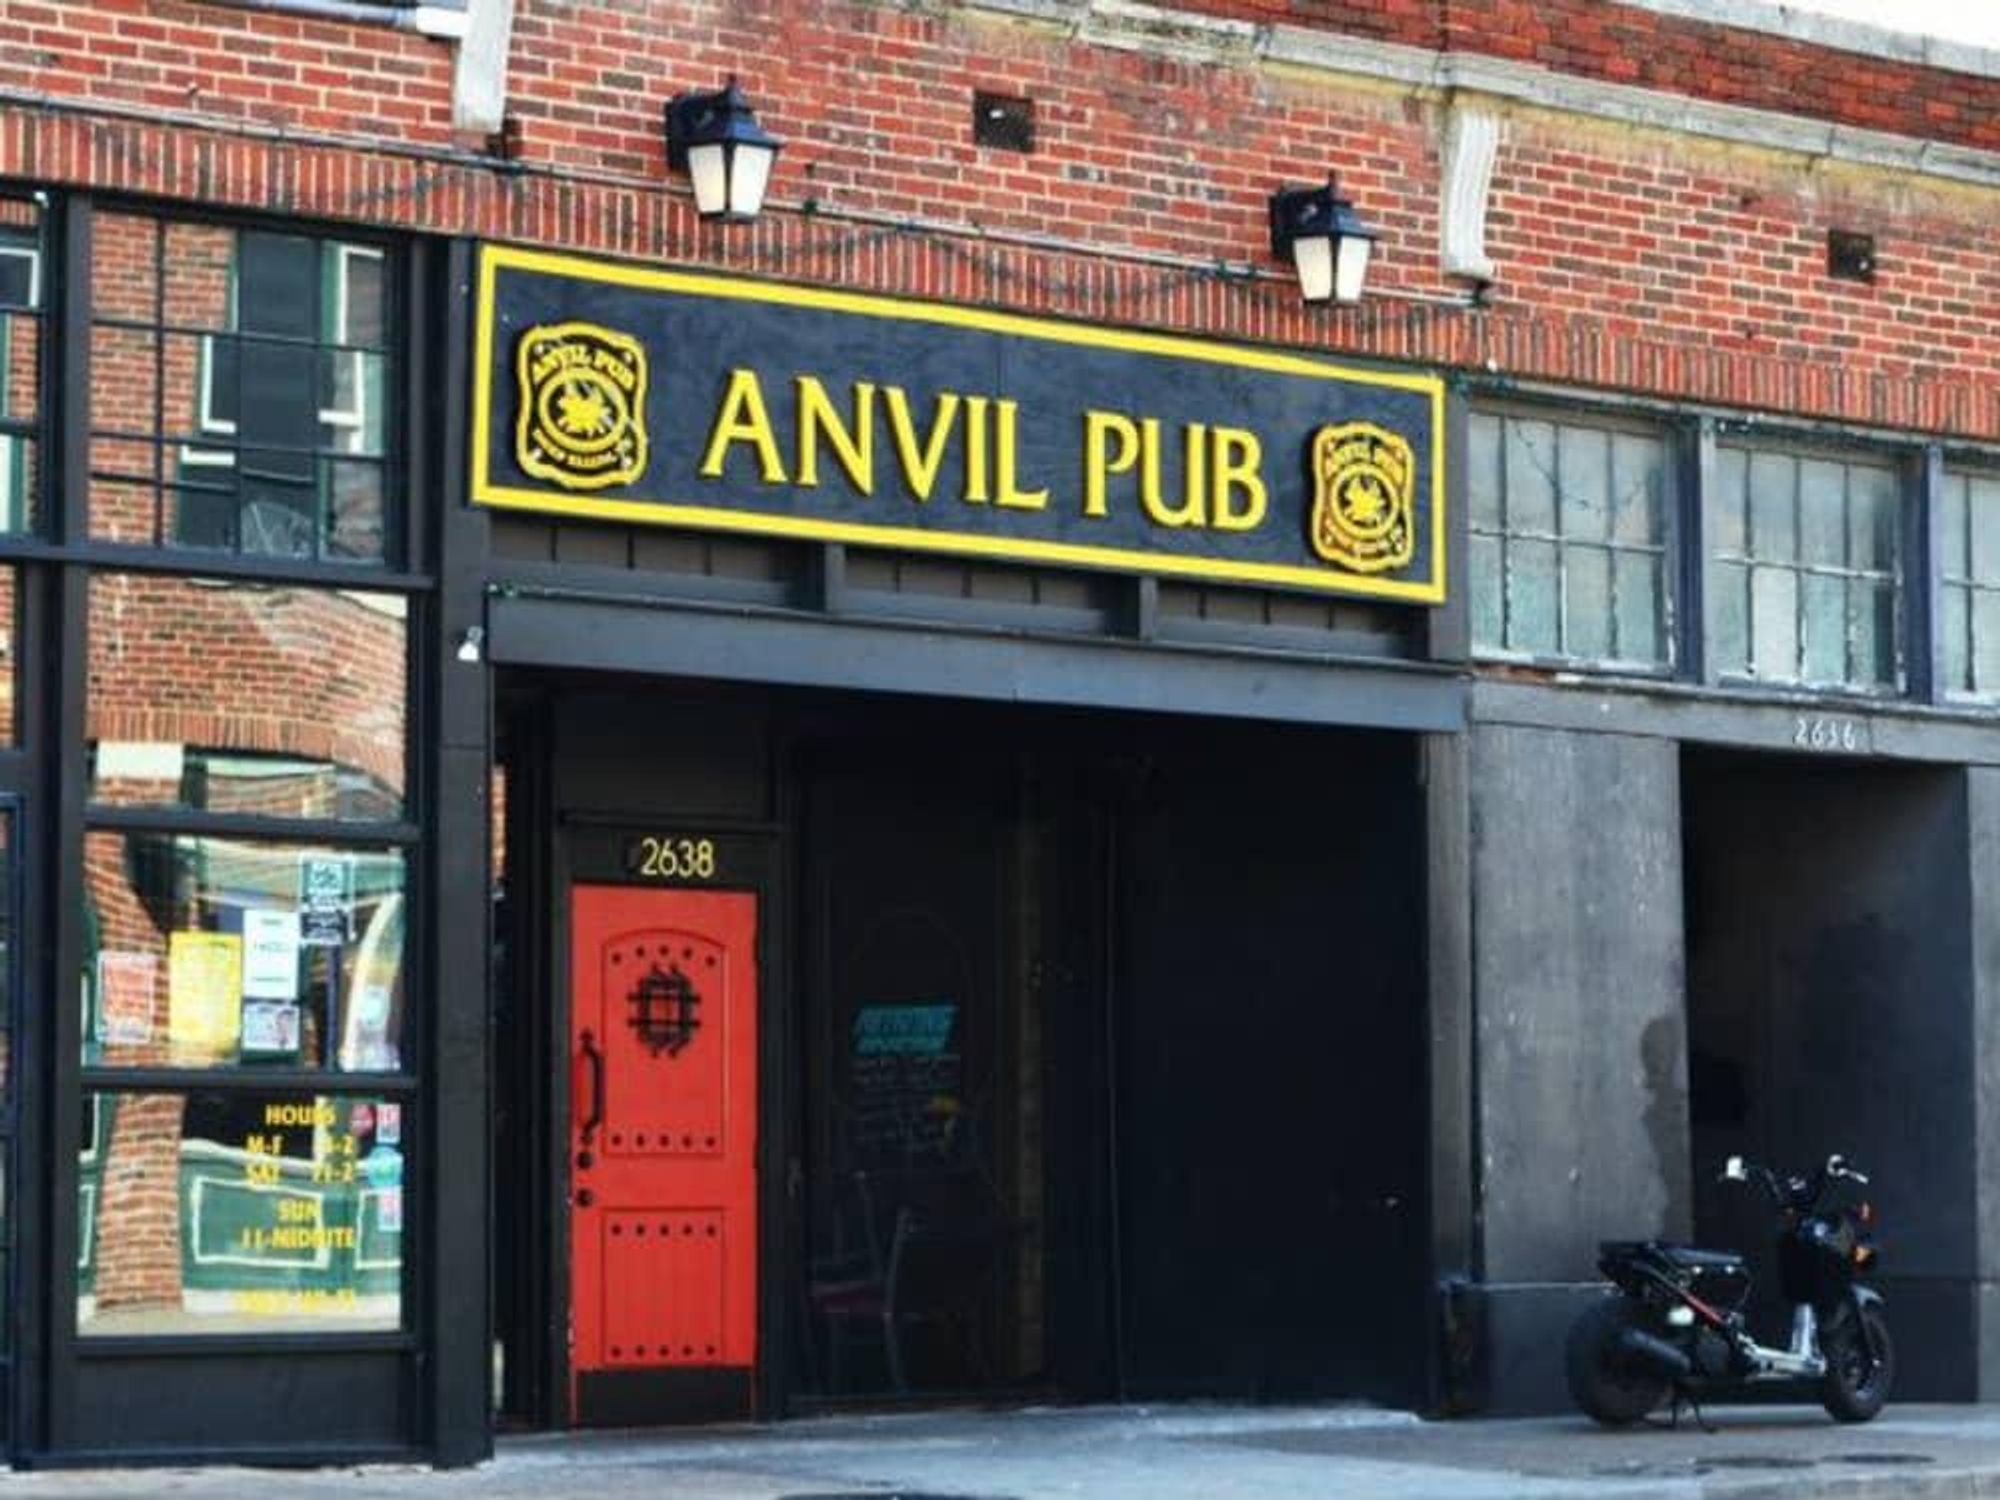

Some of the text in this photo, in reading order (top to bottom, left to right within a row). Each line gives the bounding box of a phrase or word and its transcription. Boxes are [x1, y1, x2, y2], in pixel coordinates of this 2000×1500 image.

[593, 349, 637, 390] PUB
[700, 369, 1268, 532] ANVIL PUB
[1795, 717, 1856, 751] 2636
[641, 837, 714, 878] 2638
